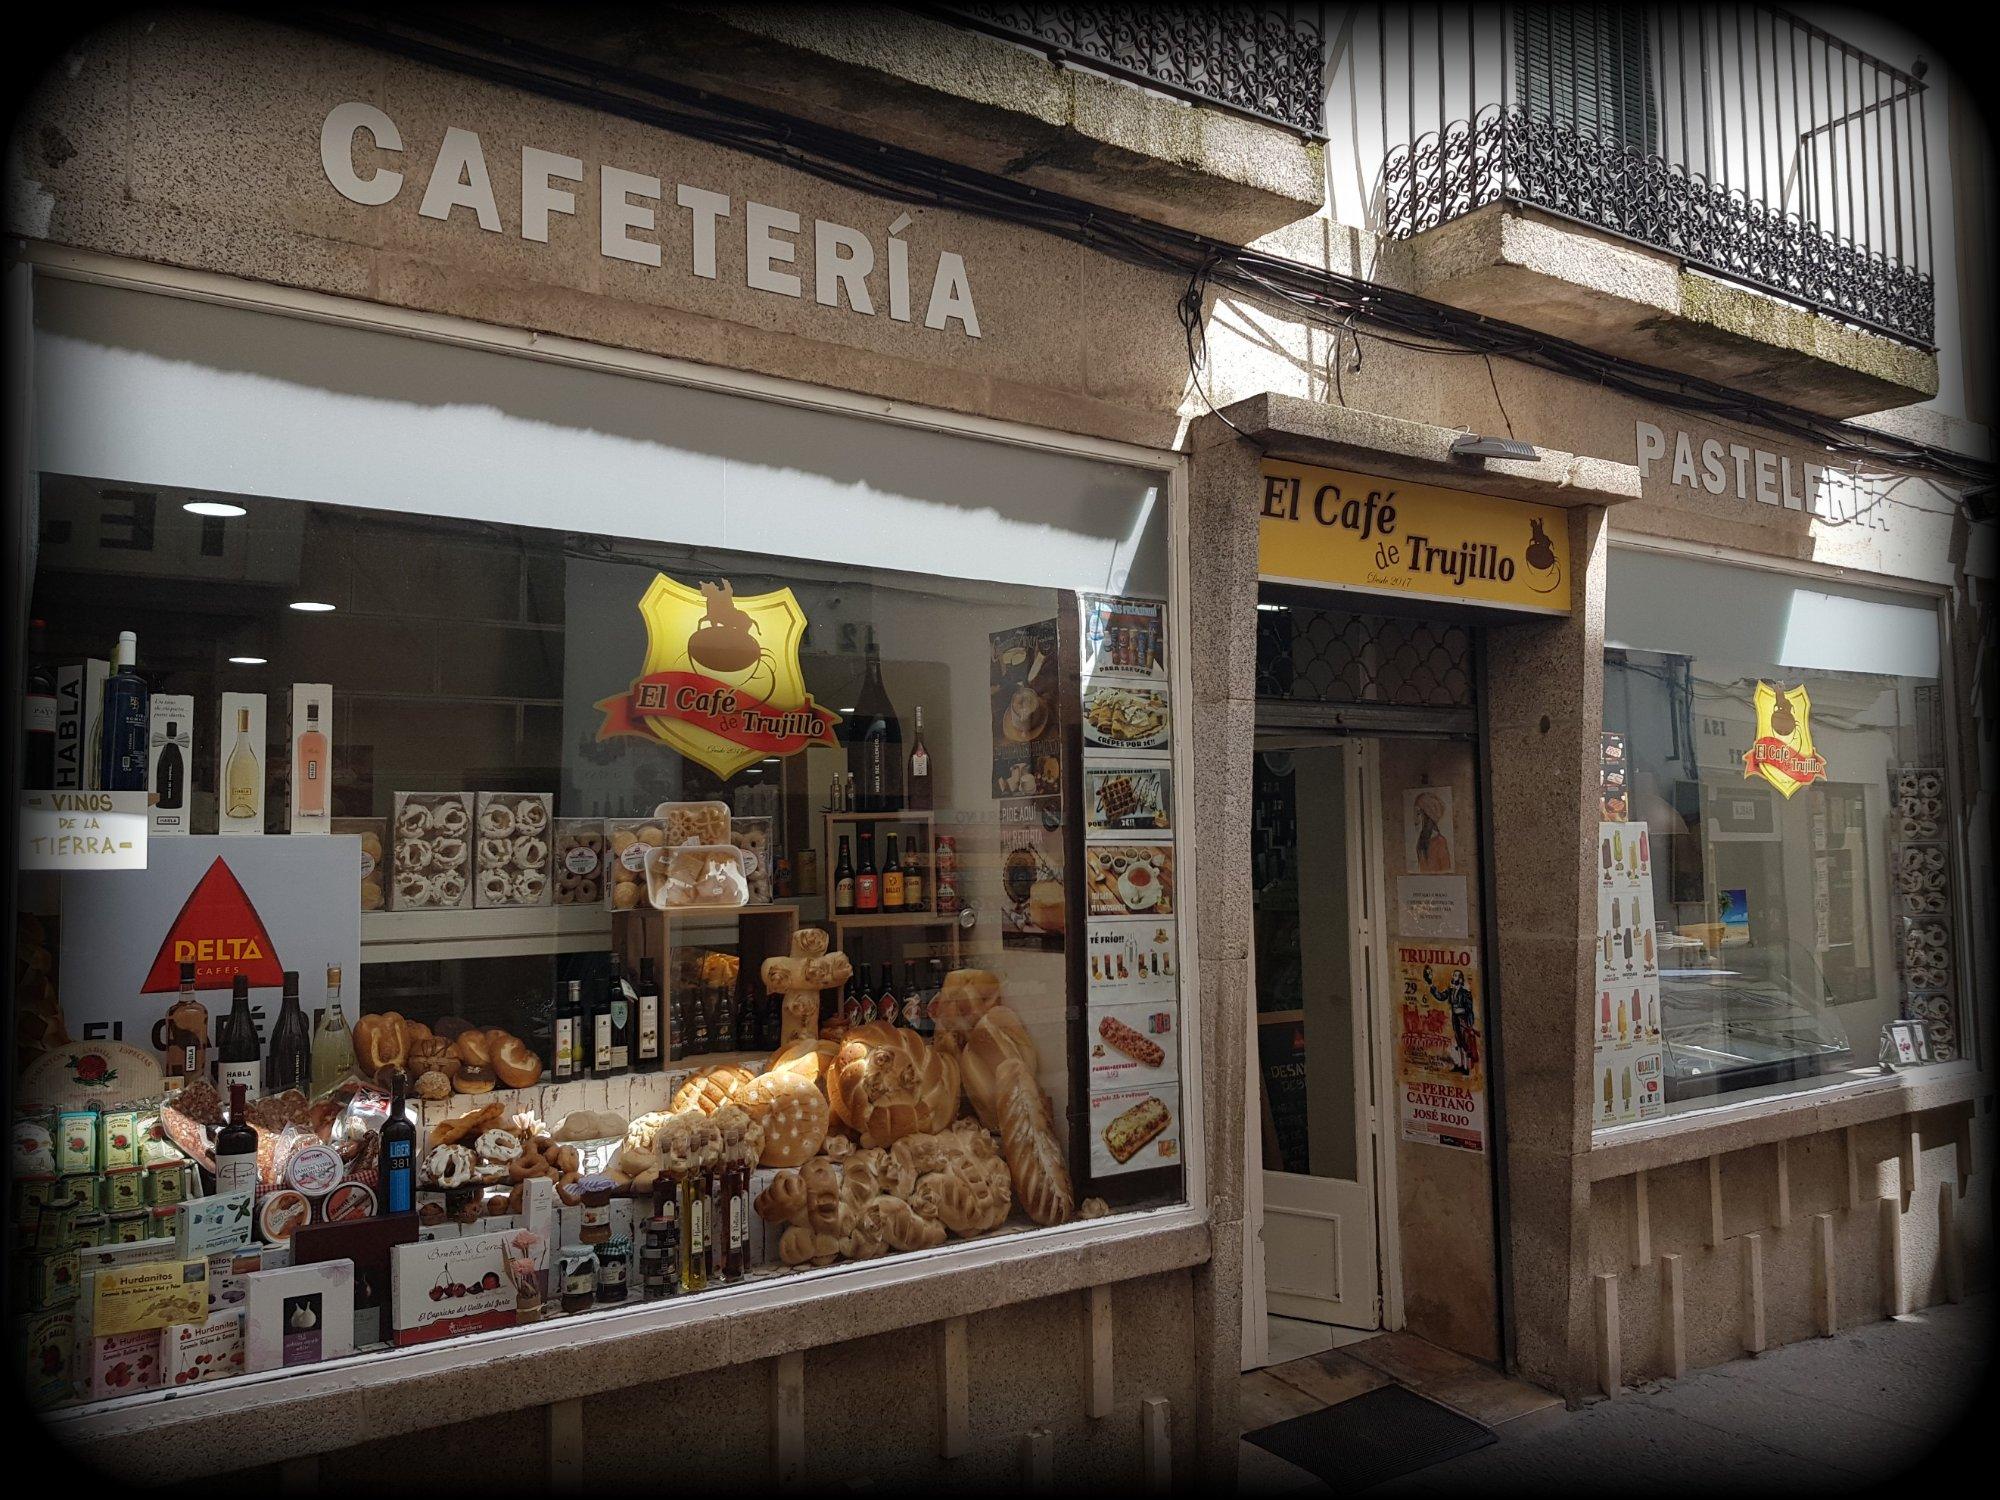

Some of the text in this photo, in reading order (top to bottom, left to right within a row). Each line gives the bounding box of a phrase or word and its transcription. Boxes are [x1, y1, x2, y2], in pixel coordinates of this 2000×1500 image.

[320, 101, 981, 338] CAFETERÍA
[1260, 475, 1396, 541] El Café
[1375, 535, 1515, 586] de Trujillo
[636, 685, 737, 716] El Café
[57, 679, 79, 787] HABLA
[719, 710, 826, 740] de Trujillo
[1756, 744, 1767, 760] El
[1768, 744, 1790, 763] Café
[1790, 758, 1822, 775] Trujillo
[51, 793, 113, 815] VINOS
[58, 817, 101, 830] DE LA
[1089, 931, 1125, 945] TÉ FRÍO!!
[174, 938, 262, 962] DELTA
[1399, 948, 1471, 966] TRUJILLO
[1422, 1082, 1473, 1100] PERERA
[1406, 1091, 1475, 1113] CAYETANO
[1413, 1108, 1469, 1126] JOSÉ ROJO
[391, 1157, 411, 1170] 381
[119, 1273, 173, 1286] Hurdanitos
